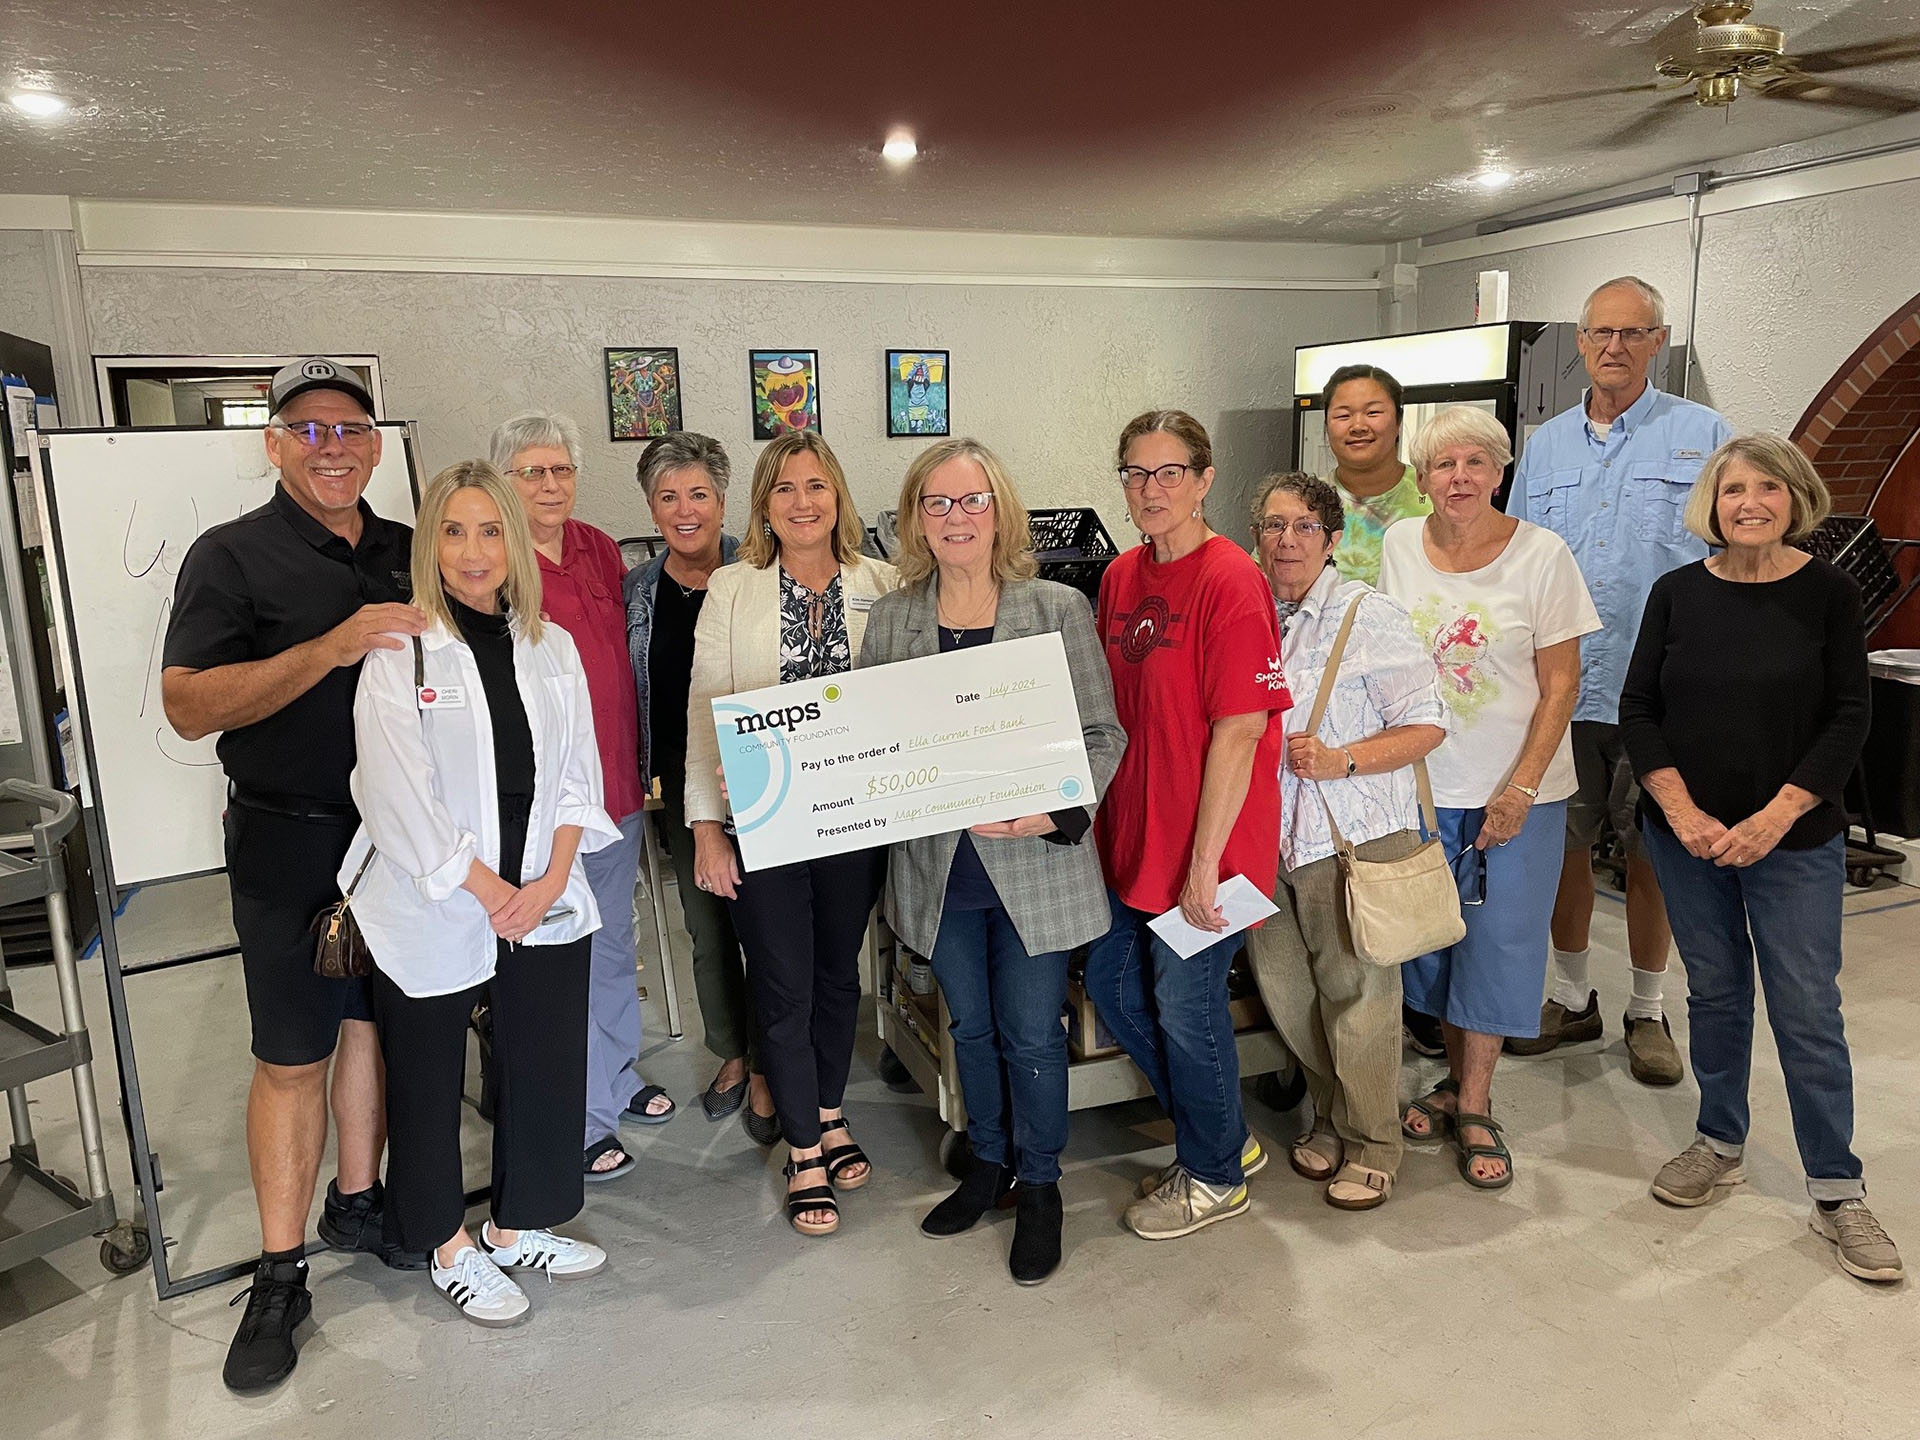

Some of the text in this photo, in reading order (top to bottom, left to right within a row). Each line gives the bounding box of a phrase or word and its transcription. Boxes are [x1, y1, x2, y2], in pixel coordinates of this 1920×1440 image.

[955, 678, 1036, 704] Date July 2024
[1255, 671, 1284, 683] SMOO
[734, 701, 821, 735] maps
[739, 725, 850, 754] COMMUNITY FOUNDATION
[801, 714, 1026, 771] Pay to the order of Ella Curran Food Bank
[812, 765, 939, 813] Amount $50,000
[816, 783, 1047, 838] Presented by Maps Community Foundation
